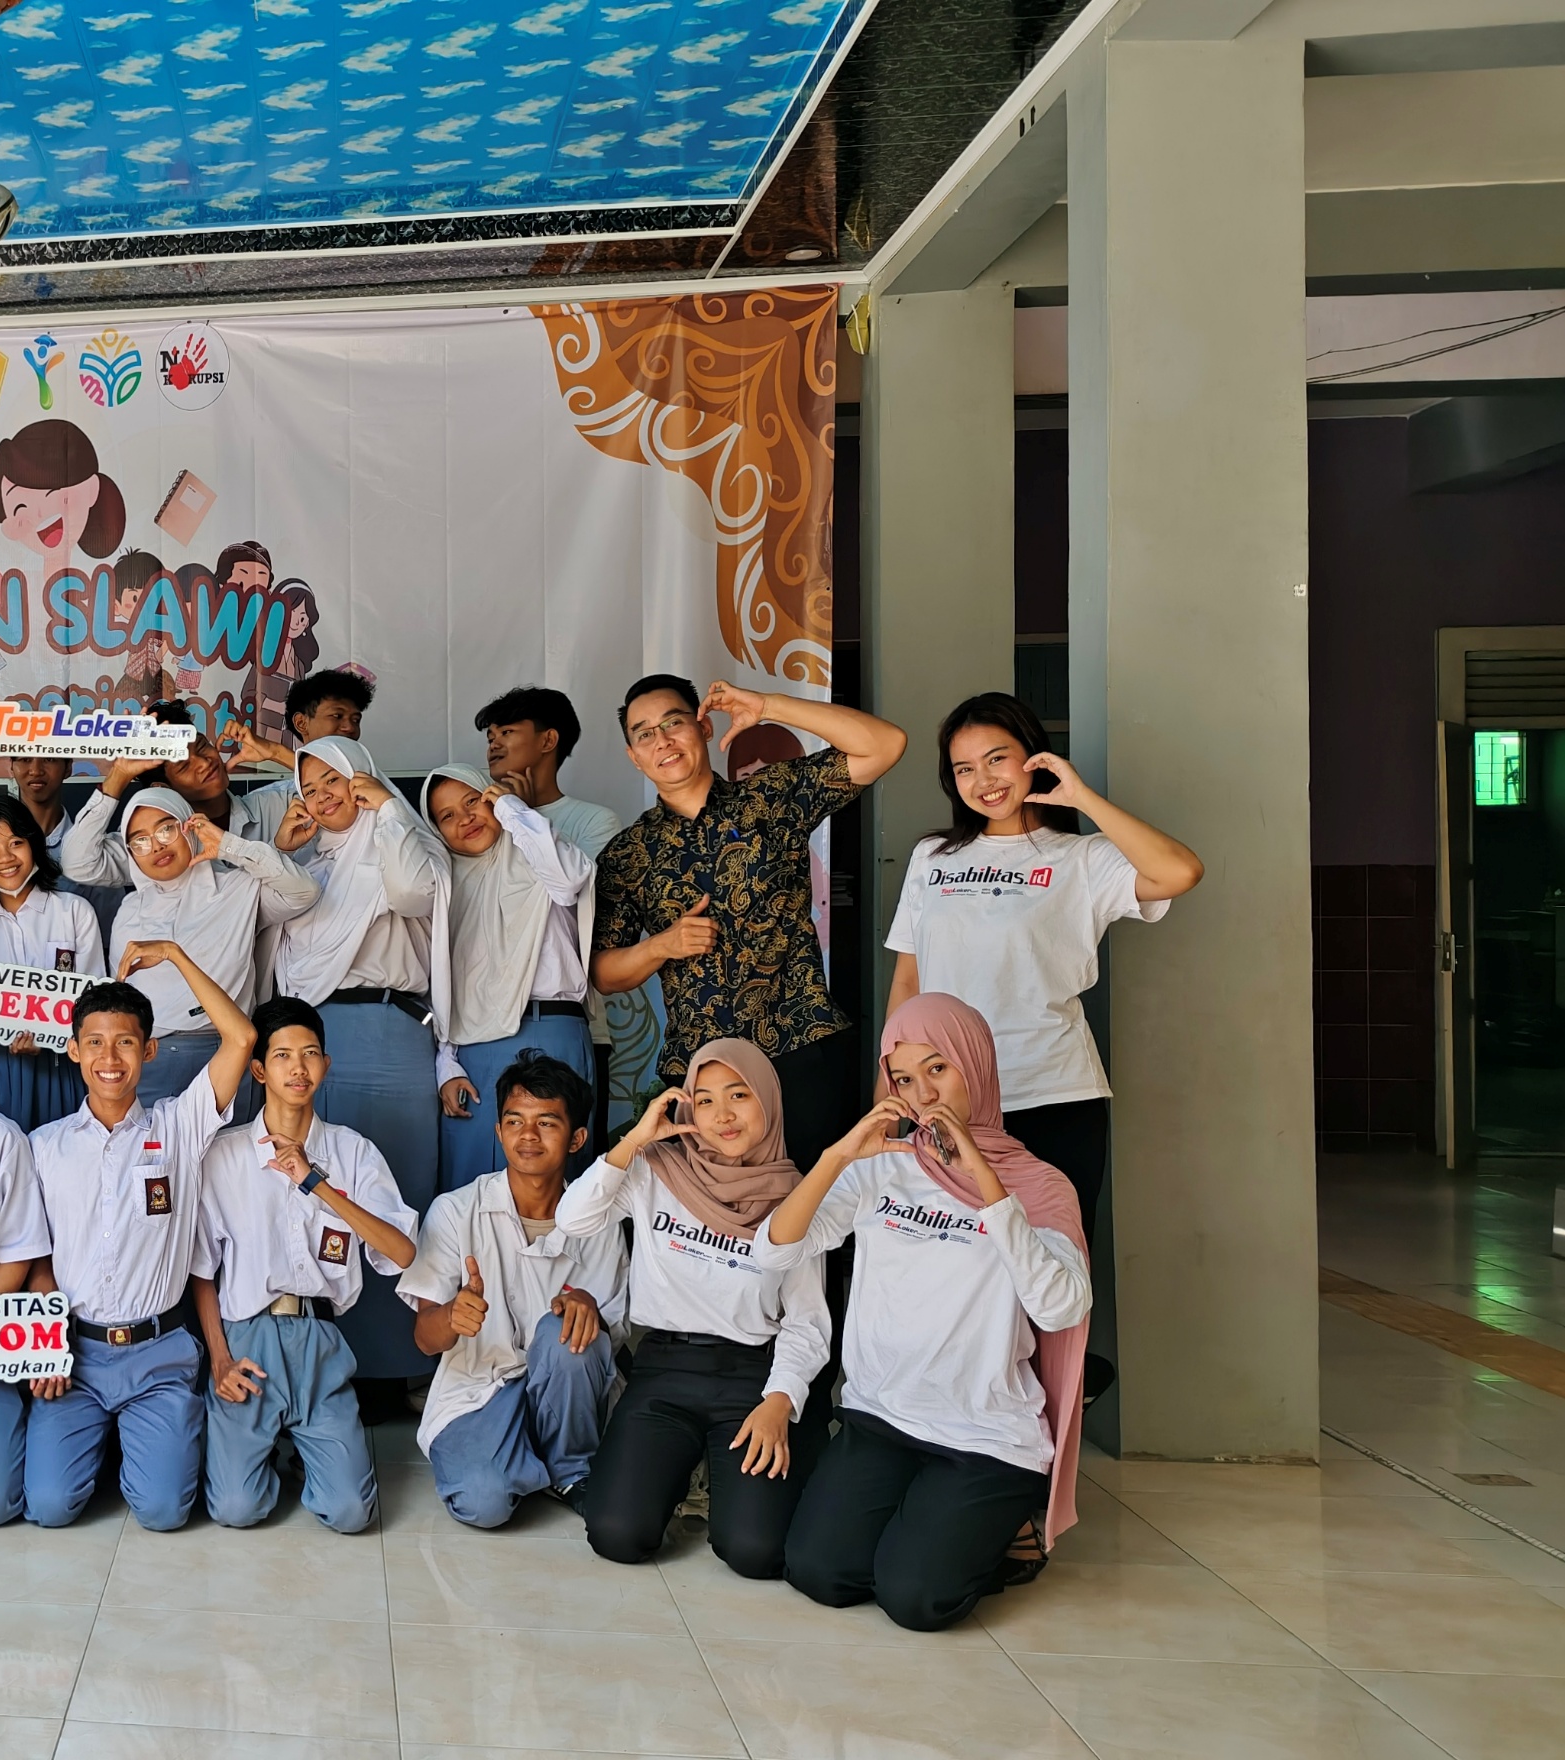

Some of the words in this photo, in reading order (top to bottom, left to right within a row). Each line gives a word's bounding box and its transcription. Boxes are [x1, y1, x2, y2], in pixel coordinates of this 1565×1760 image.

[163, 372, 224, 386] KRUPSI
[46, 567, 289, 672] SLAWI
[928, 866, 1053, 888] Disabilitas.id
[652, 1211, 754, 1258] Disabilita
[875, 1196, 988, 1235] Disabilitas.
